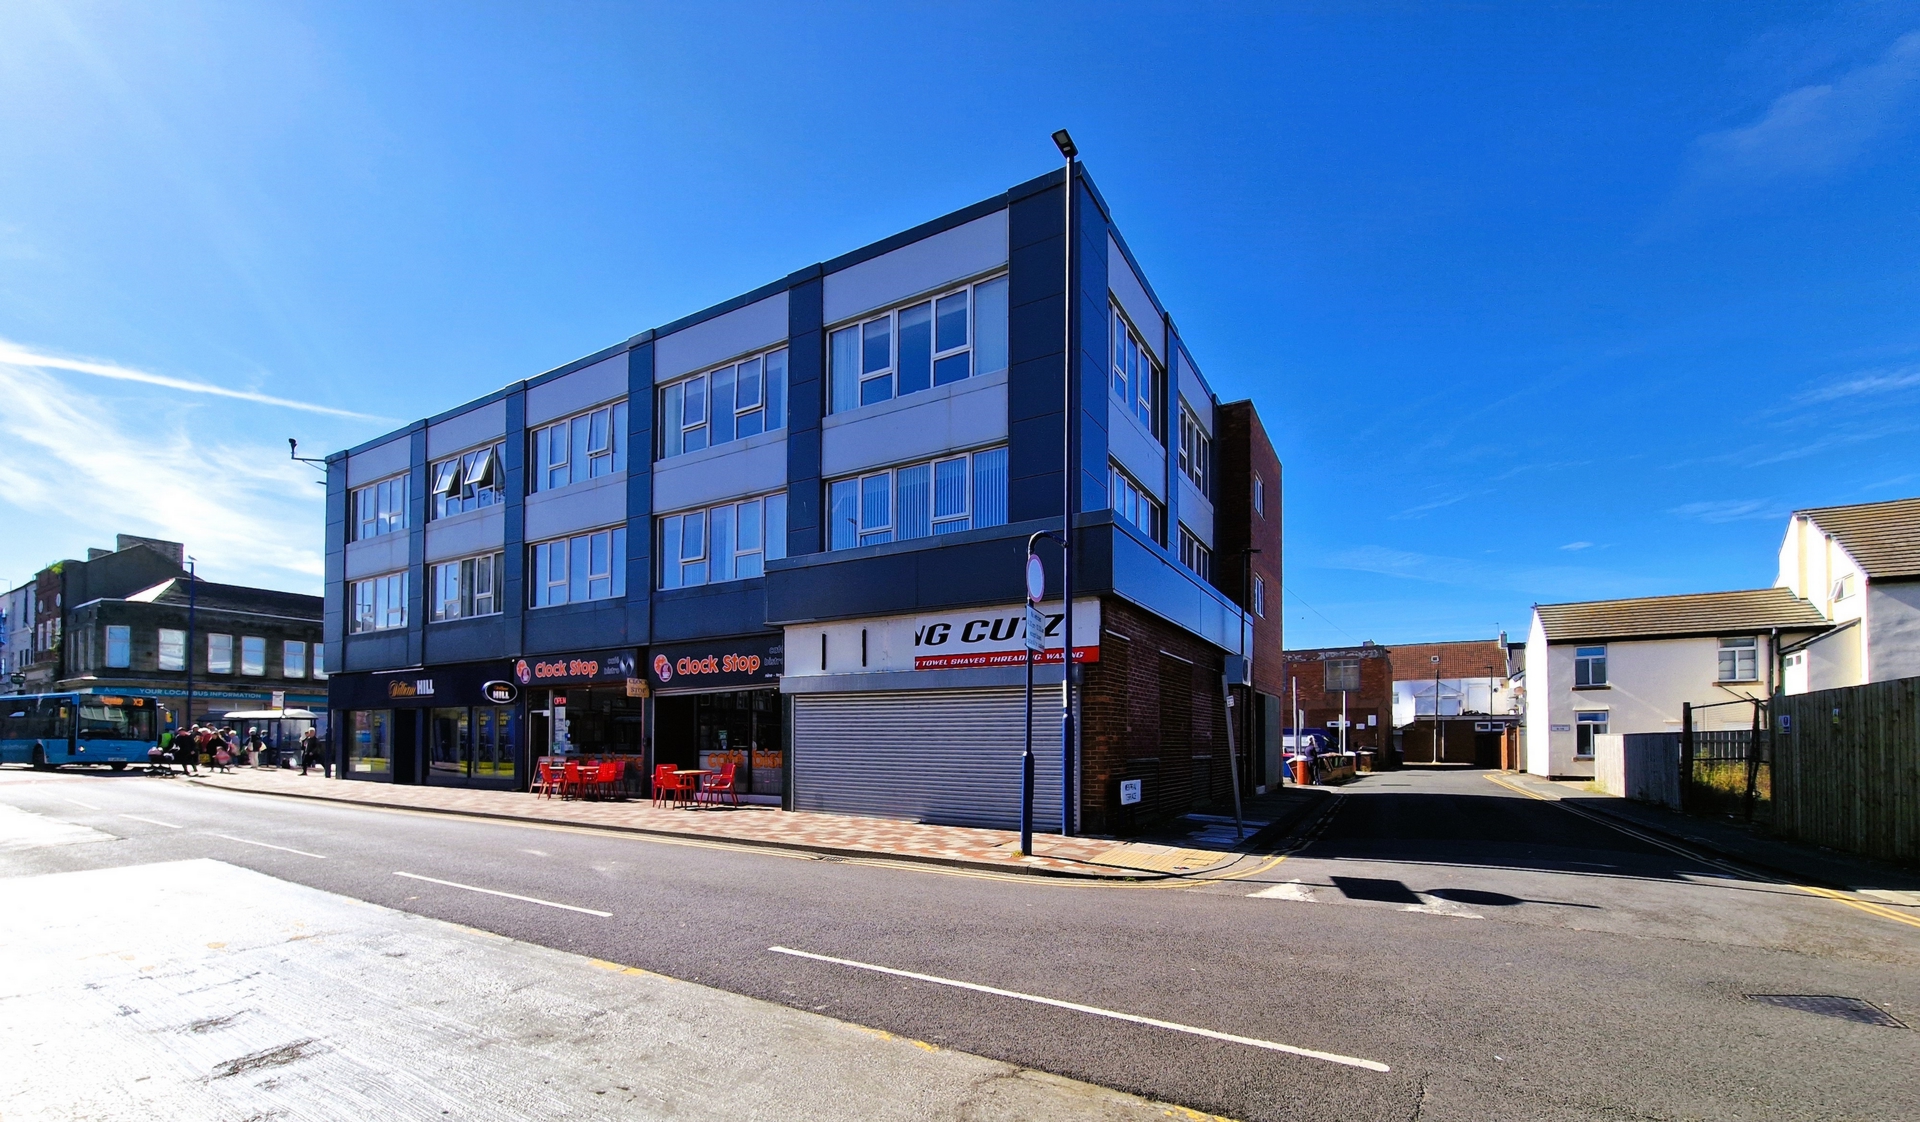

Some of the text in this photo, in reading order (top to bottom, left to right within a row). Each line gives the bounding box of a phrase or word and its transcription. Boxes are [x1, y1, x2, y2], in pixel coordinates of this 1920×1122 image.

[961, 613, 1065, 643] CUZ
[676, 653, 760, 675] Clock Stop
[922, 659, 948, 667] TOWEL
[950, 656, 986, 665] SHAVES
[535, 658, 598, 678] Clock Stop
[417, 679, 434, 695] HILL
[209, 691, 262, 699] INFORMATION
[493, 690, 510, 699] HILL
[132, 698, 144, 707] X3
[554, 696, 567, 705] OPEN
